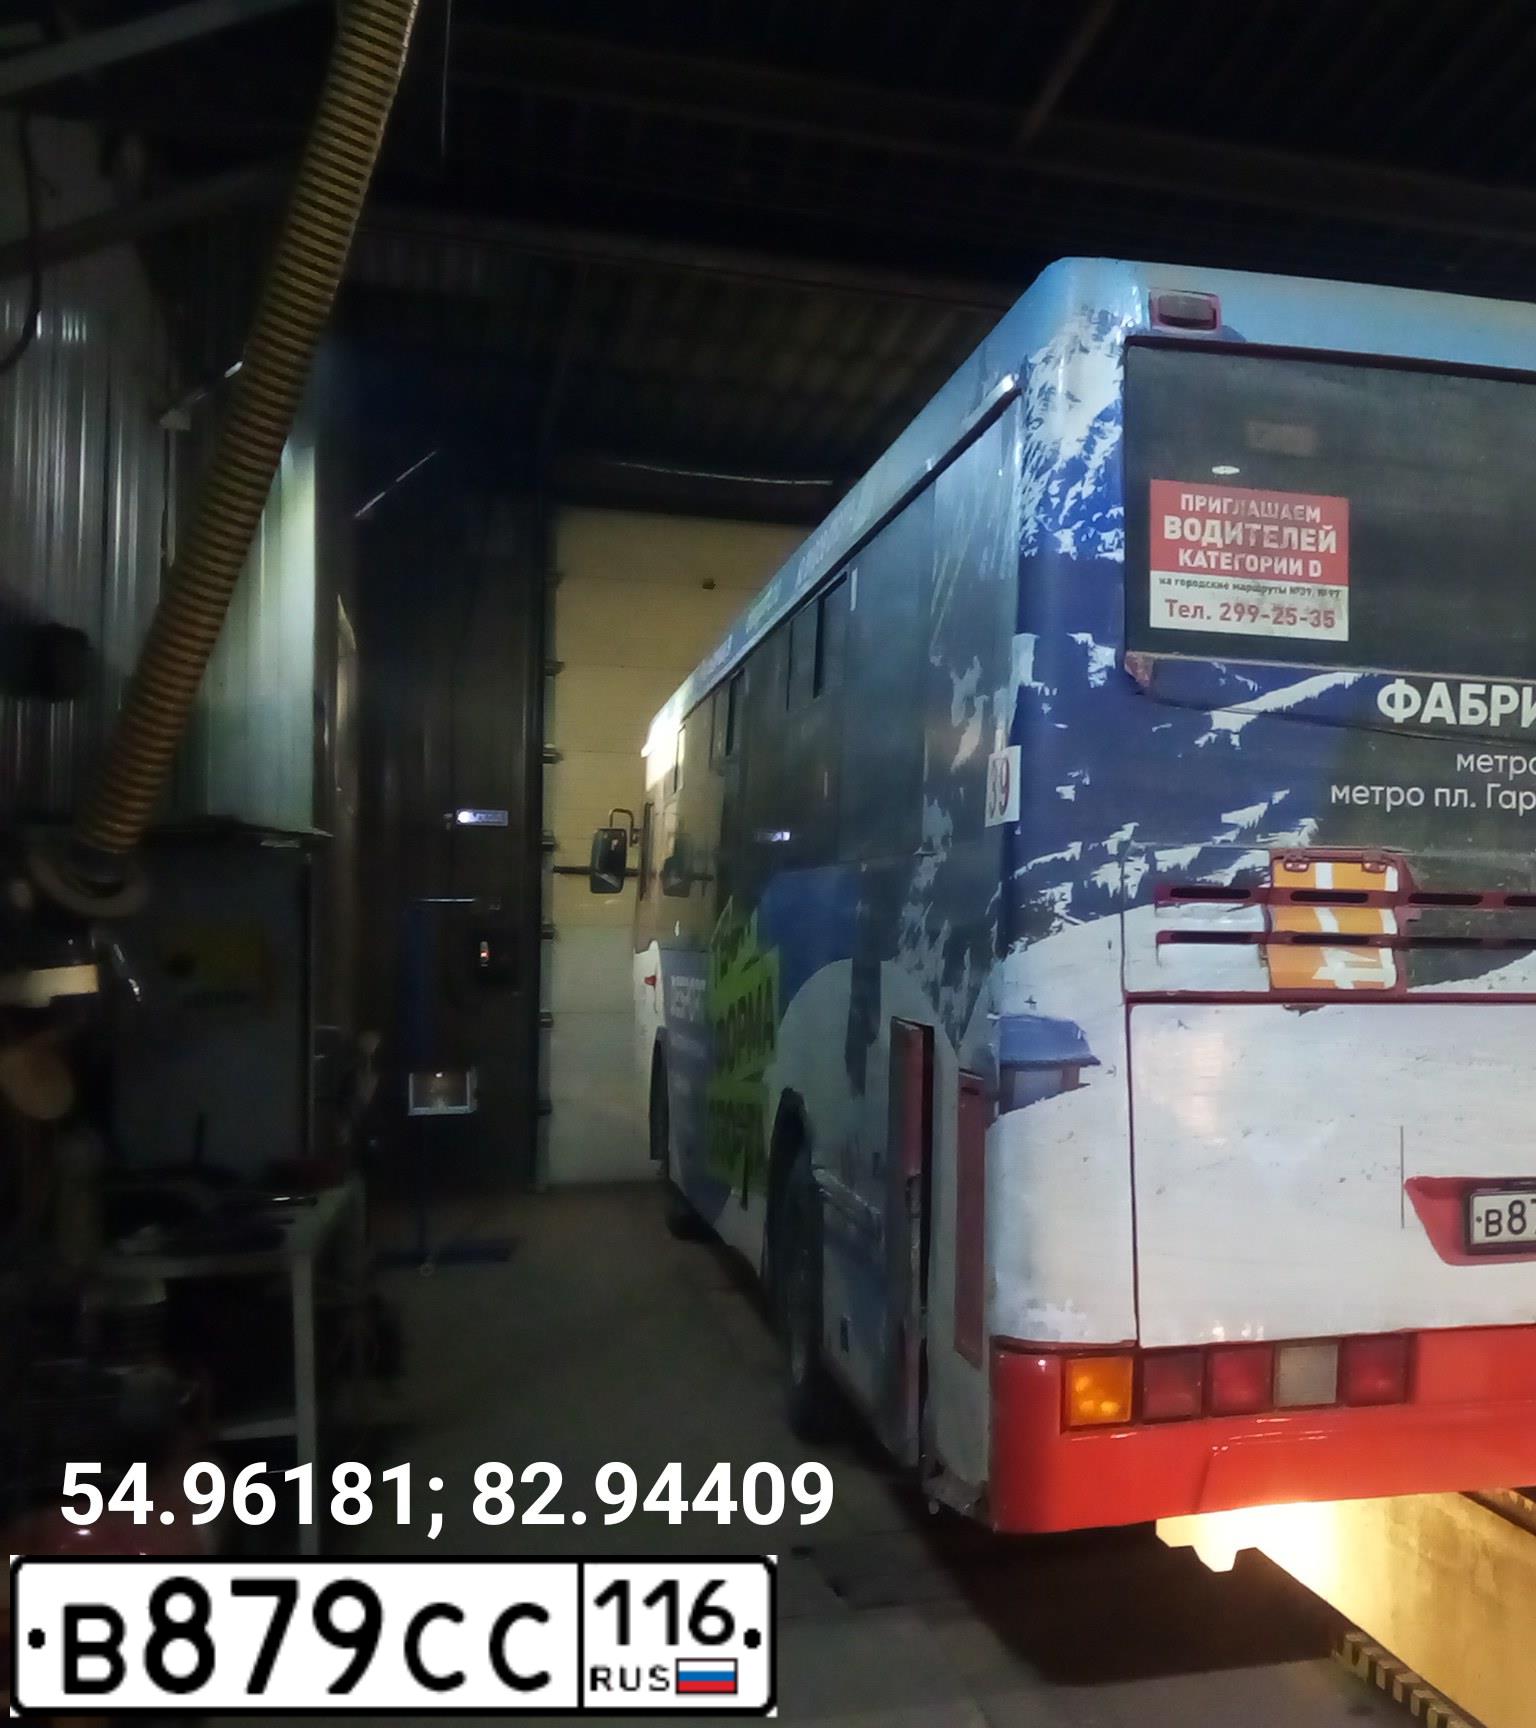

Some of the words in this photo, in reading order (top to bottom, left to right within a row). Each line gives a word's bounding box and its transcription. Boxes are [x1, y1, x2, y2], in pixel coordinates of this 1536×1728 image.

[1180, 493, 1321, 523] ПРИГЛАШАЕМ
[1163, 514, 1337, 554] ВОДИТЕЛЕЙ
[1178, 547, 1303, 577] КАТЕГОРИИ
[1308, 559, 1322, 578] D
[1159, 576, 1172, 586] на
[1174, 577, 1230, 590] городские
[1232, 582, 1287, 596] маршруты
[1164, 598, 1212, 621] Тел.
[1219, 601, 1337, 629] 299-25-35
[1330, 782, 1426, 813] метро
[1434, 787, 1477, 809] пл.
